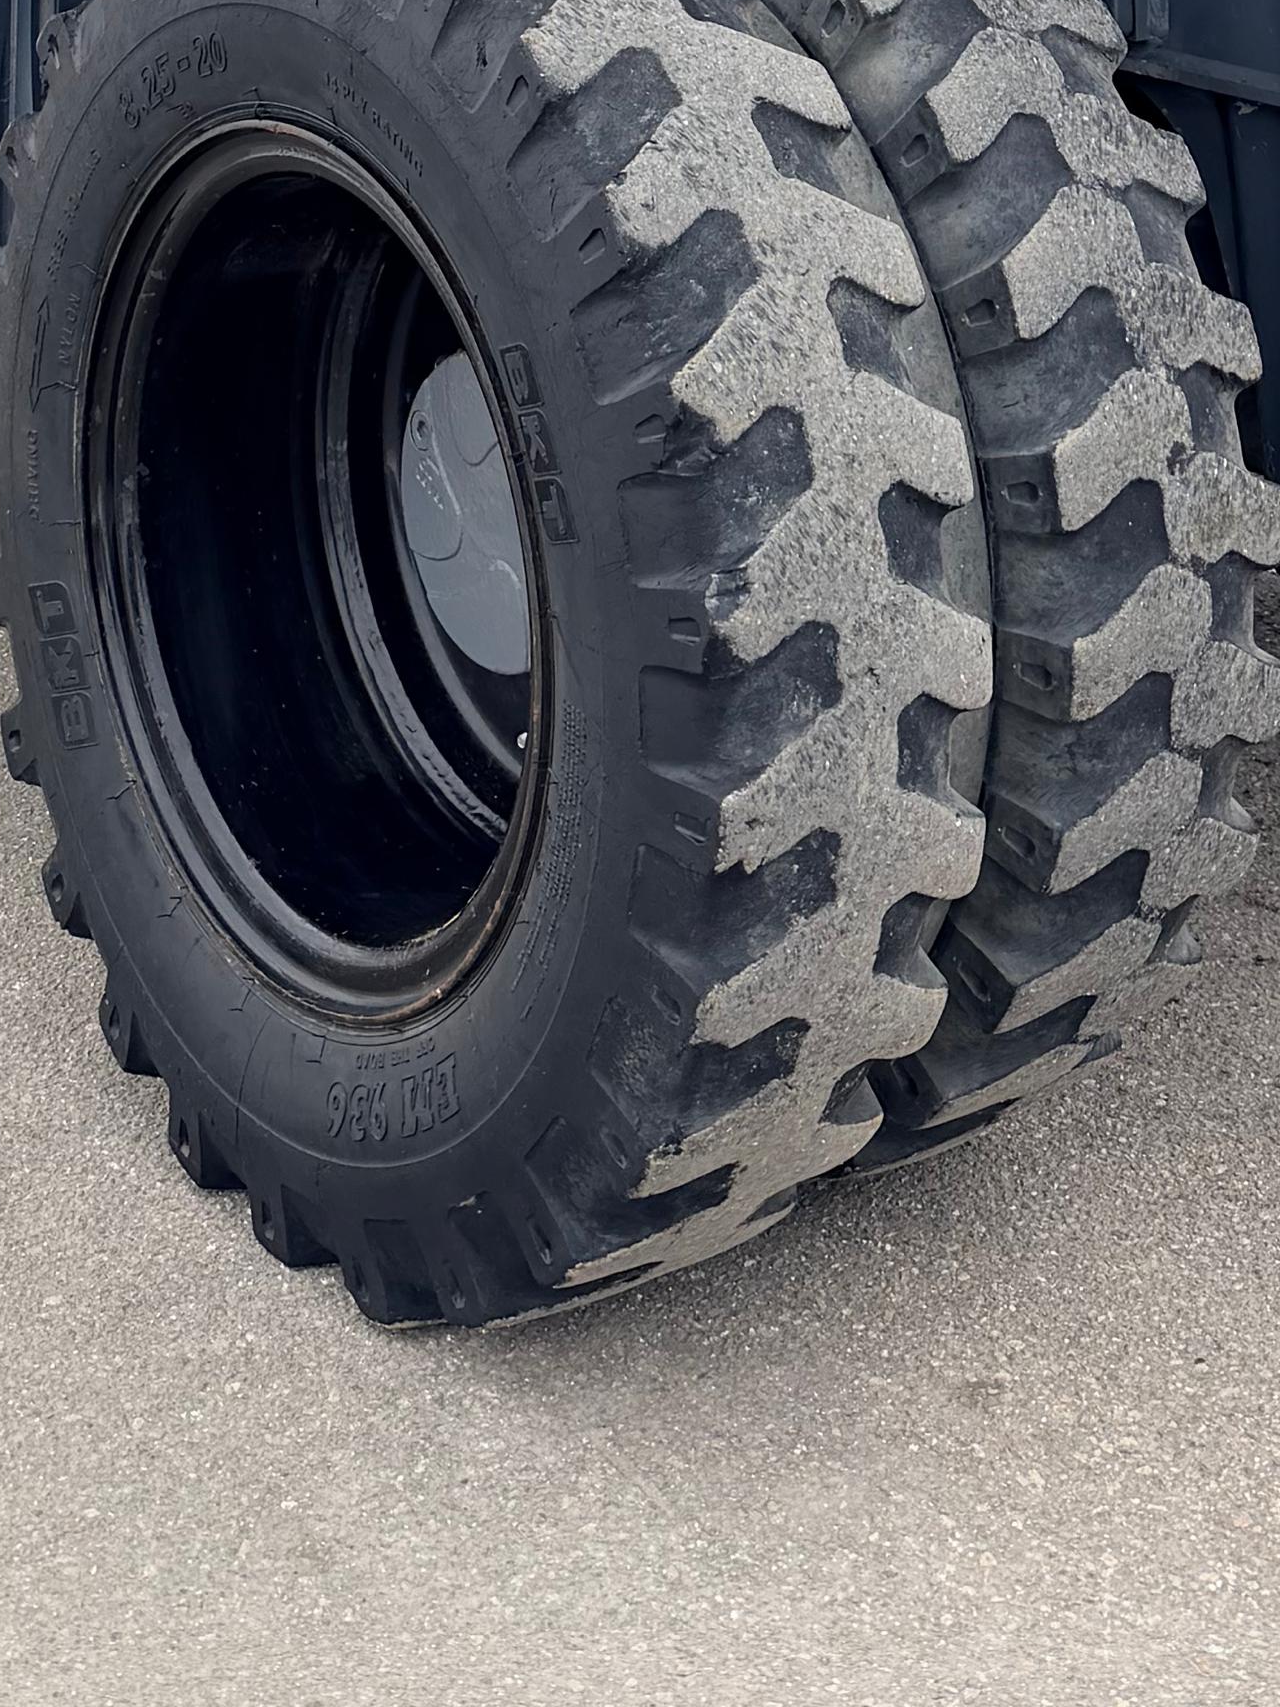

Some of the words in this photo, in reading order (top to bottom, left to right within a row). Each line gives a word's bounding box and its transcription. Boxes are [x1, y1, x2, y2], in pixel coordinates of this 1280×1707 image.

[500, 343, 580, 544] BKT
[29, 580, 99, 750] BKT
[326, 1081, 388, 1142] 936
[401, 1051, 461, 1138] EM
